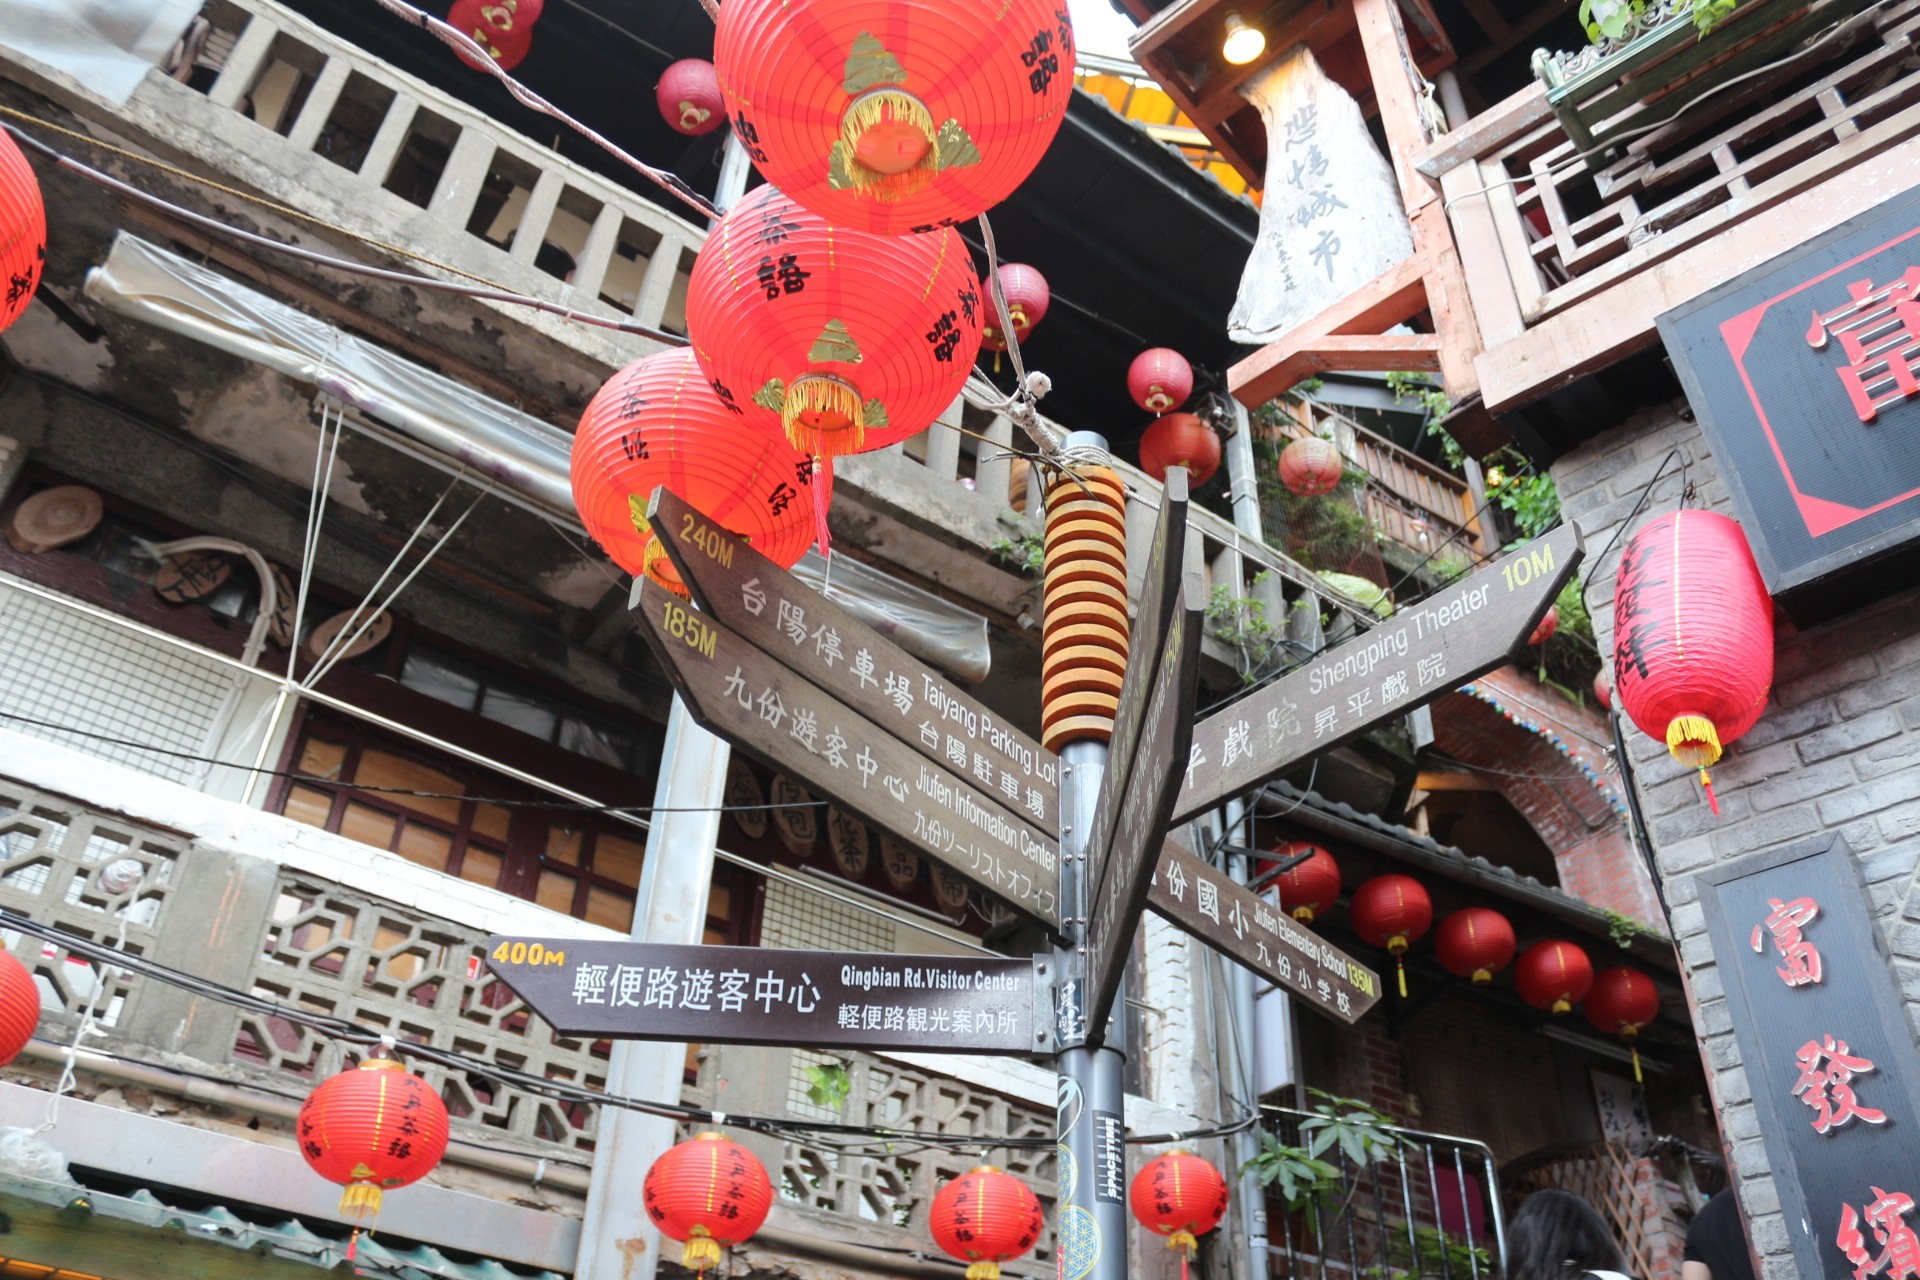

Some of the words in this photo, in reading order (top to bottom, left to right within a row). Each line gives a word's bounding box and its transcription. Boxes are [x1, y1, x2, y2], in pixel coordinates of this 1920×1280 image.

[1284, 103, 1348, 282] 悲情城市
[679, 514, 734, 570] 240M
[1501, 543, 1555, 592] 10M
[662, 601, 717, 660] 185M
[741, 578, 914, 717] 台陽停車場
[1309, 628, 1408, 694] Shengping
[1411, 584, 1489, 640] Theater
[723, 667, 910, 803] 九份遊客中心
[919, 721, 1044, 819] 台陽駐車場
[922, 673, 976, 738] Taiyang
[981, 714, 1031, 776] Parking
[1036, 750, 1056, 787] Lot
[914, 810, 1056, 918] 九份ツーリストオフィス
[916, 765, 951, 810] Jiufen
[956, 787, 1017, 850] Information
[1021, 830, 1057, 873] Center
[1151, 859, 1250, 940] 份國小
[572, 962, 821, 1014] 輕便路遊客中心
[841, 965, 900, 991] Qingbian
[974, 970, 1019, 992] Center
[1254, 902, 1277, 936] Jiufen
[1278, 917, 1321, 968] Elementary
[1321, 944, 1347, 980] School
[1347, 963, 1374, 998] 135M
[1256, 941, 1352, 1017] 九份小学校
[1105, 1116, 1117, 1199] SPACETIME
